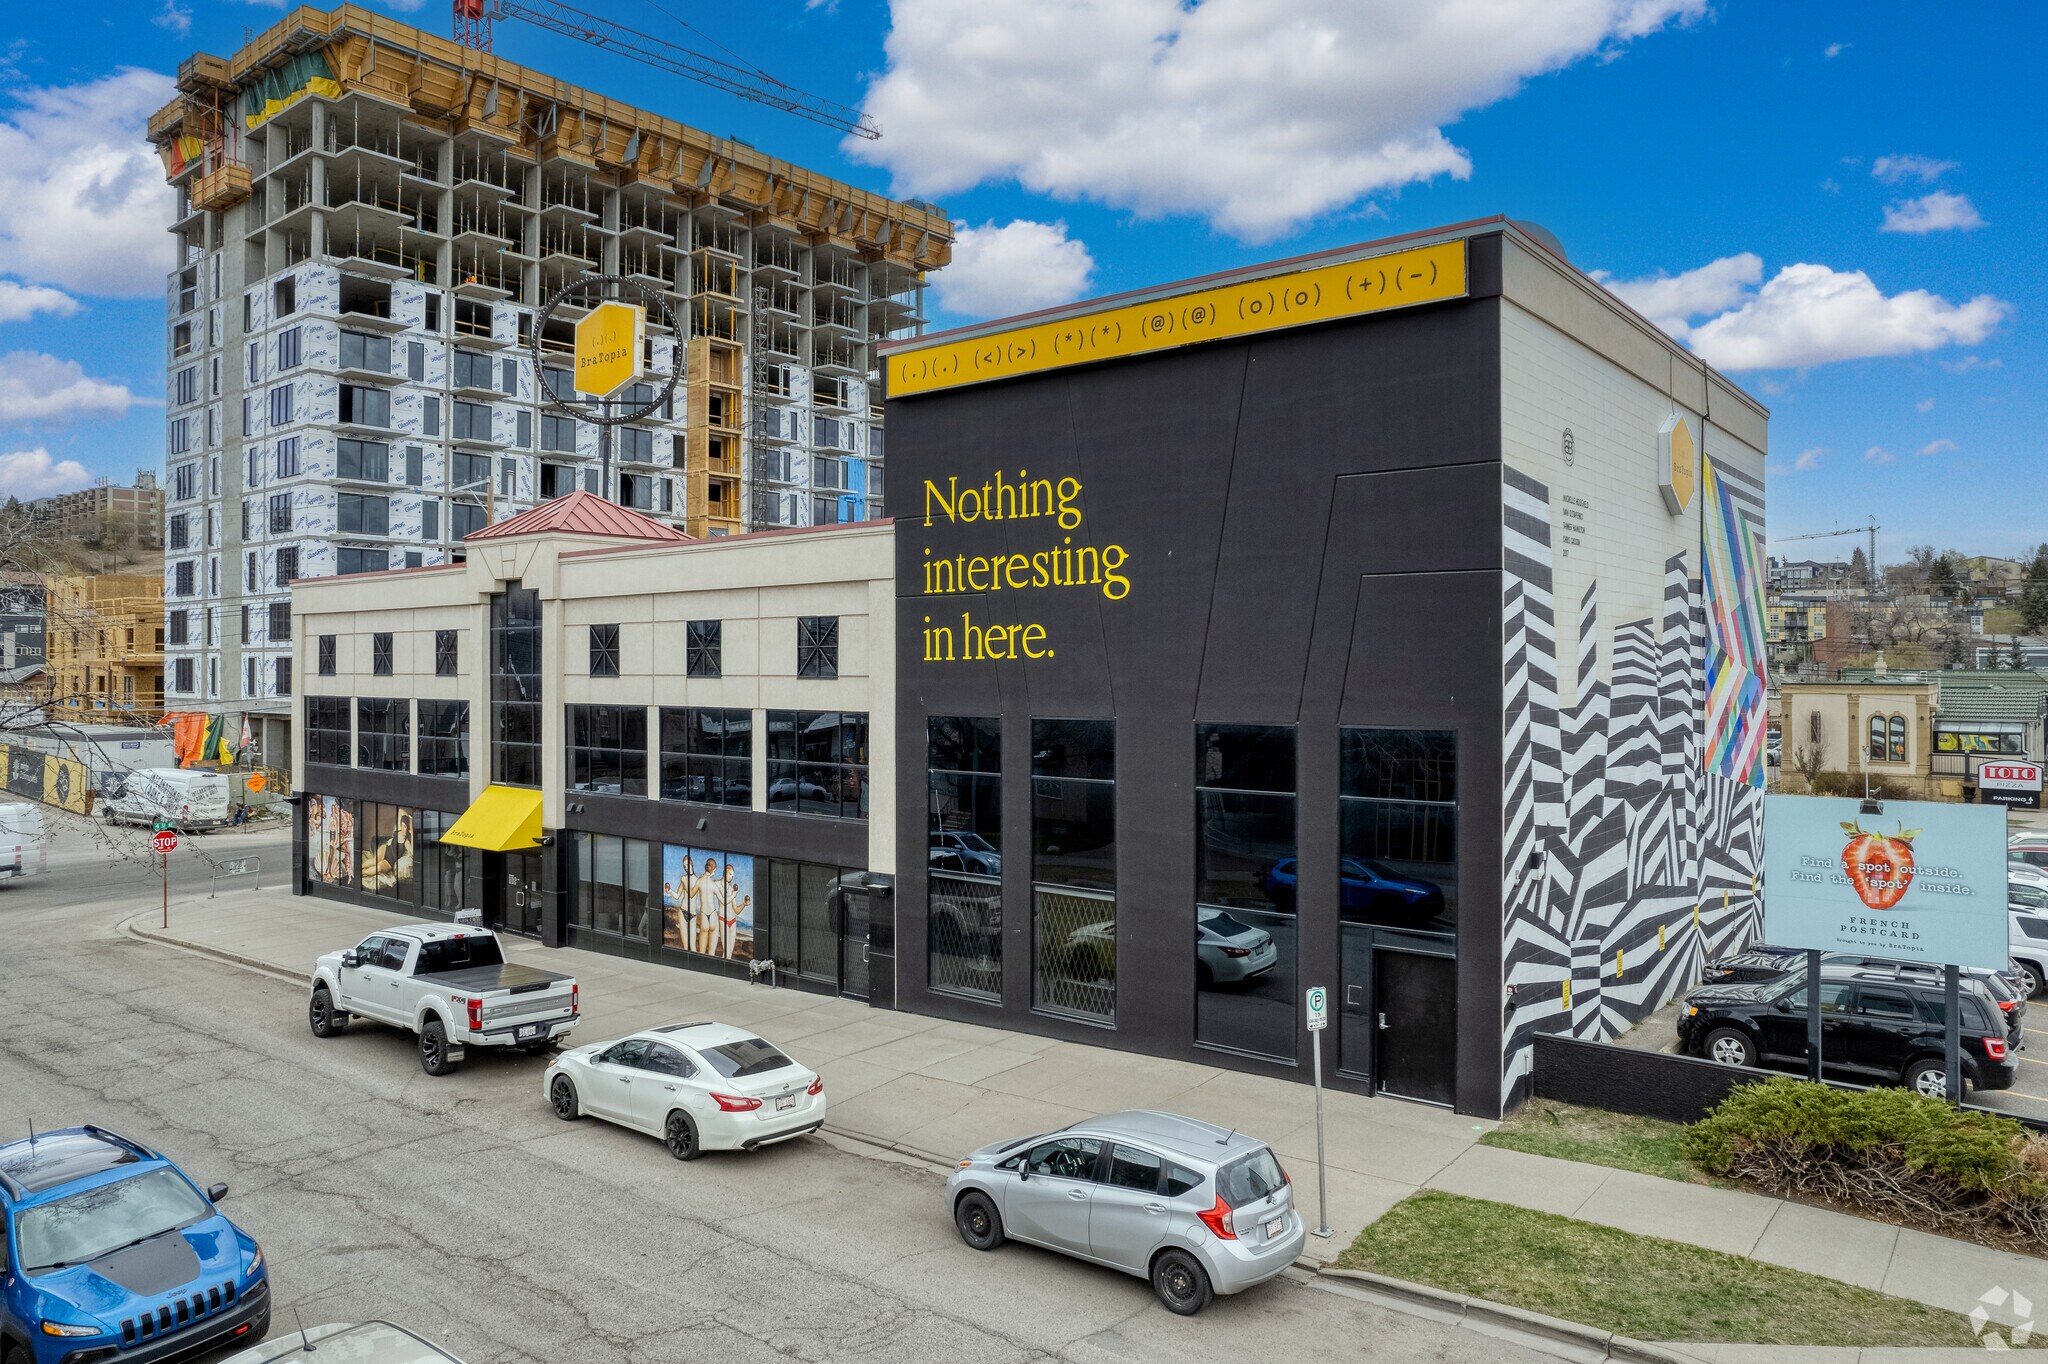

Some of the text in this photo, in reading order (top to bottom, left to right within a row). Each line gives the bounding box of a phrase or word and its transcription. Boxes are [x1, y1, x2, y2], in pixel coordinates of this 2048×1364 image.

[924, 470, 1082, 530] Nothing
[924, 536, 1131, 600] interesting
[924, 612, 1054, 661] in here.
[1986, 766, 2034, 780] TOTO
[154, 838, 176, 848] STOP
[1801, 856, 1964, 879] Find a spot outside.
[1791, 871, 1822, 883] Find
[1831, 874, 1854, 885] the
[1920, 881, 1976, 896] inside.
[1850, 917, 1910, 929] FRENCH
[1840, 925, 1920, 940] POSTCARD
[1889, 943, 1924, 952] BraTopia
[451, 995, 466, 1004] FX4
[1315, 995, 1321, 1007] P
[166, 1287, 188, 1299] Jeep
